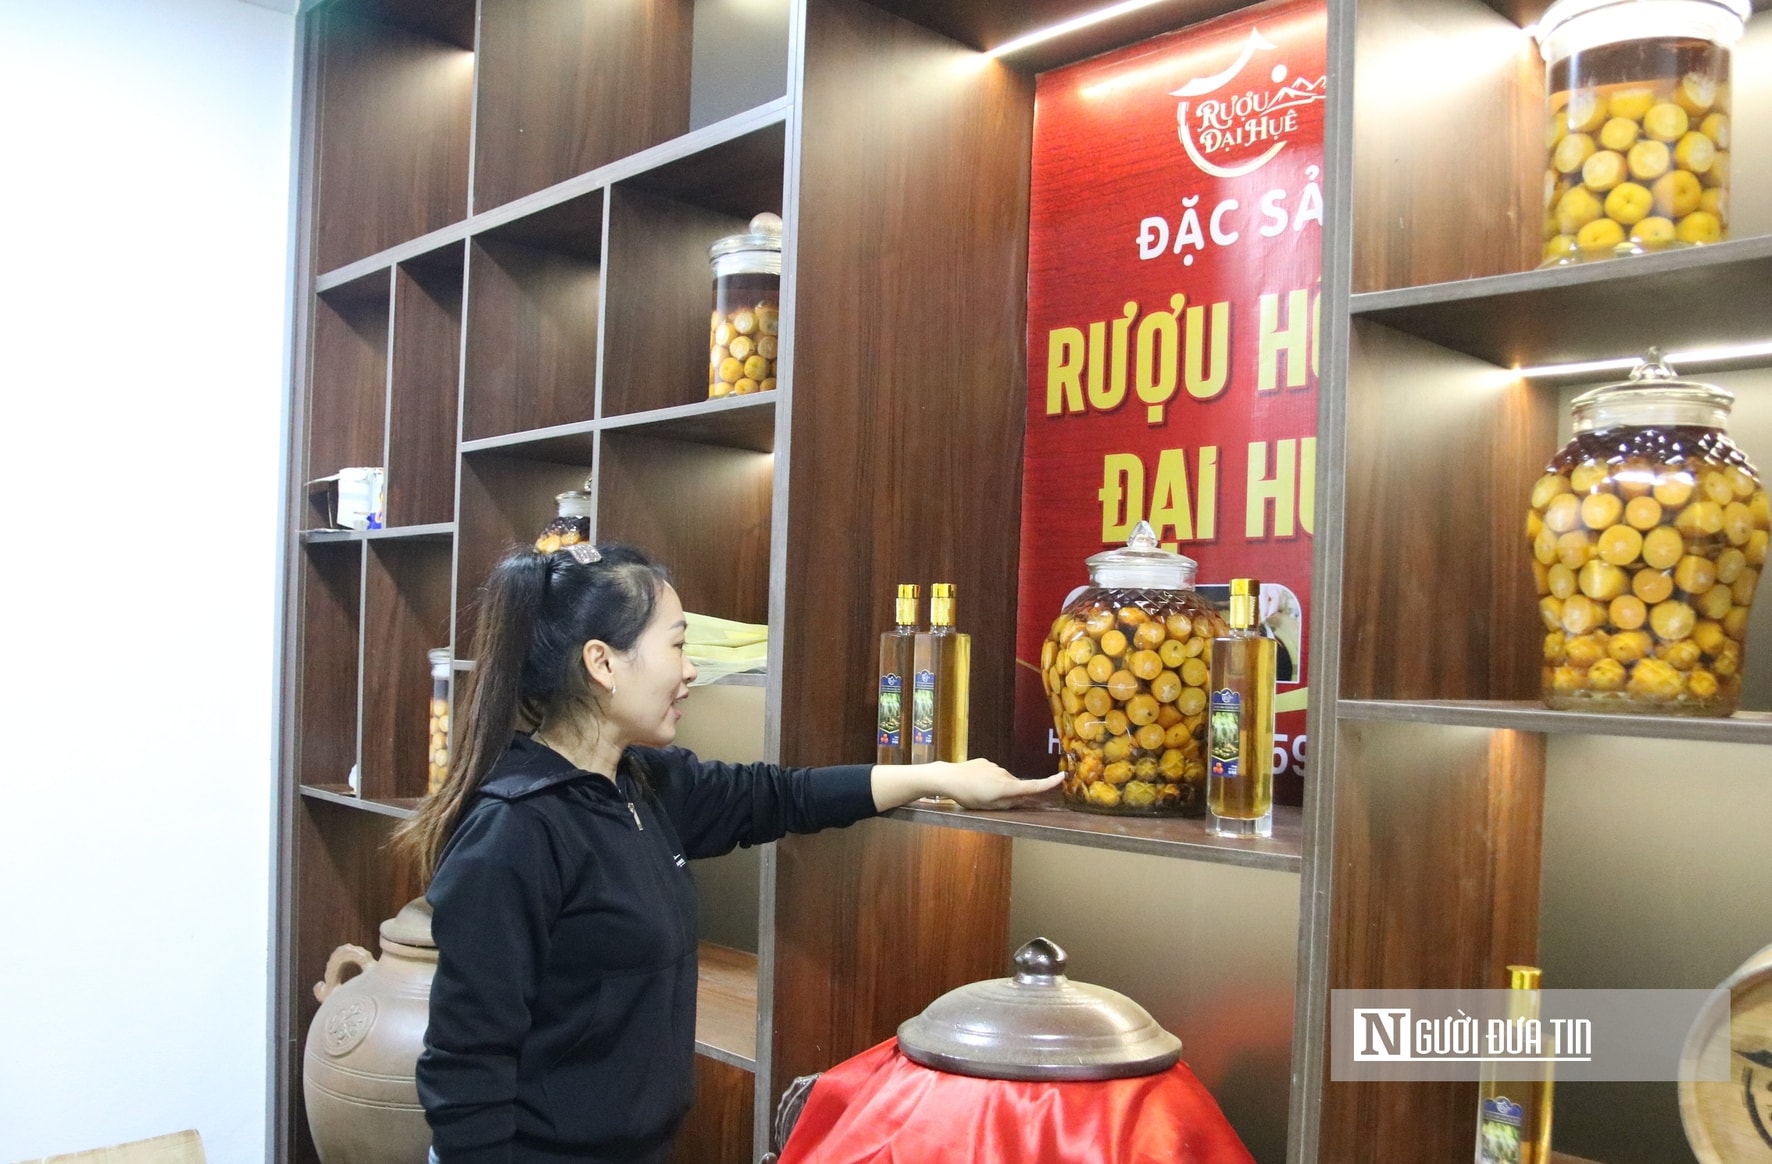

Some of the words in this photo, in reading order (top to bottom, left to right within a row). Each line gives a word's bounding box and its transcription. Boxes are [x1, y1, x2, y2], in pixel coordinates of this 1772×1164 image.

[1196, 91, 1269, 132] RƯỢU
[1200, 129, 1242, 153] ĐẠI
[1136, 194, 1239, 267] ĐẶC
[1046, 292, 1230, 424] RƯỢU
[1257, 288, 1321, 392] H
[1098, 445, 1218, 555] ĐẠI
